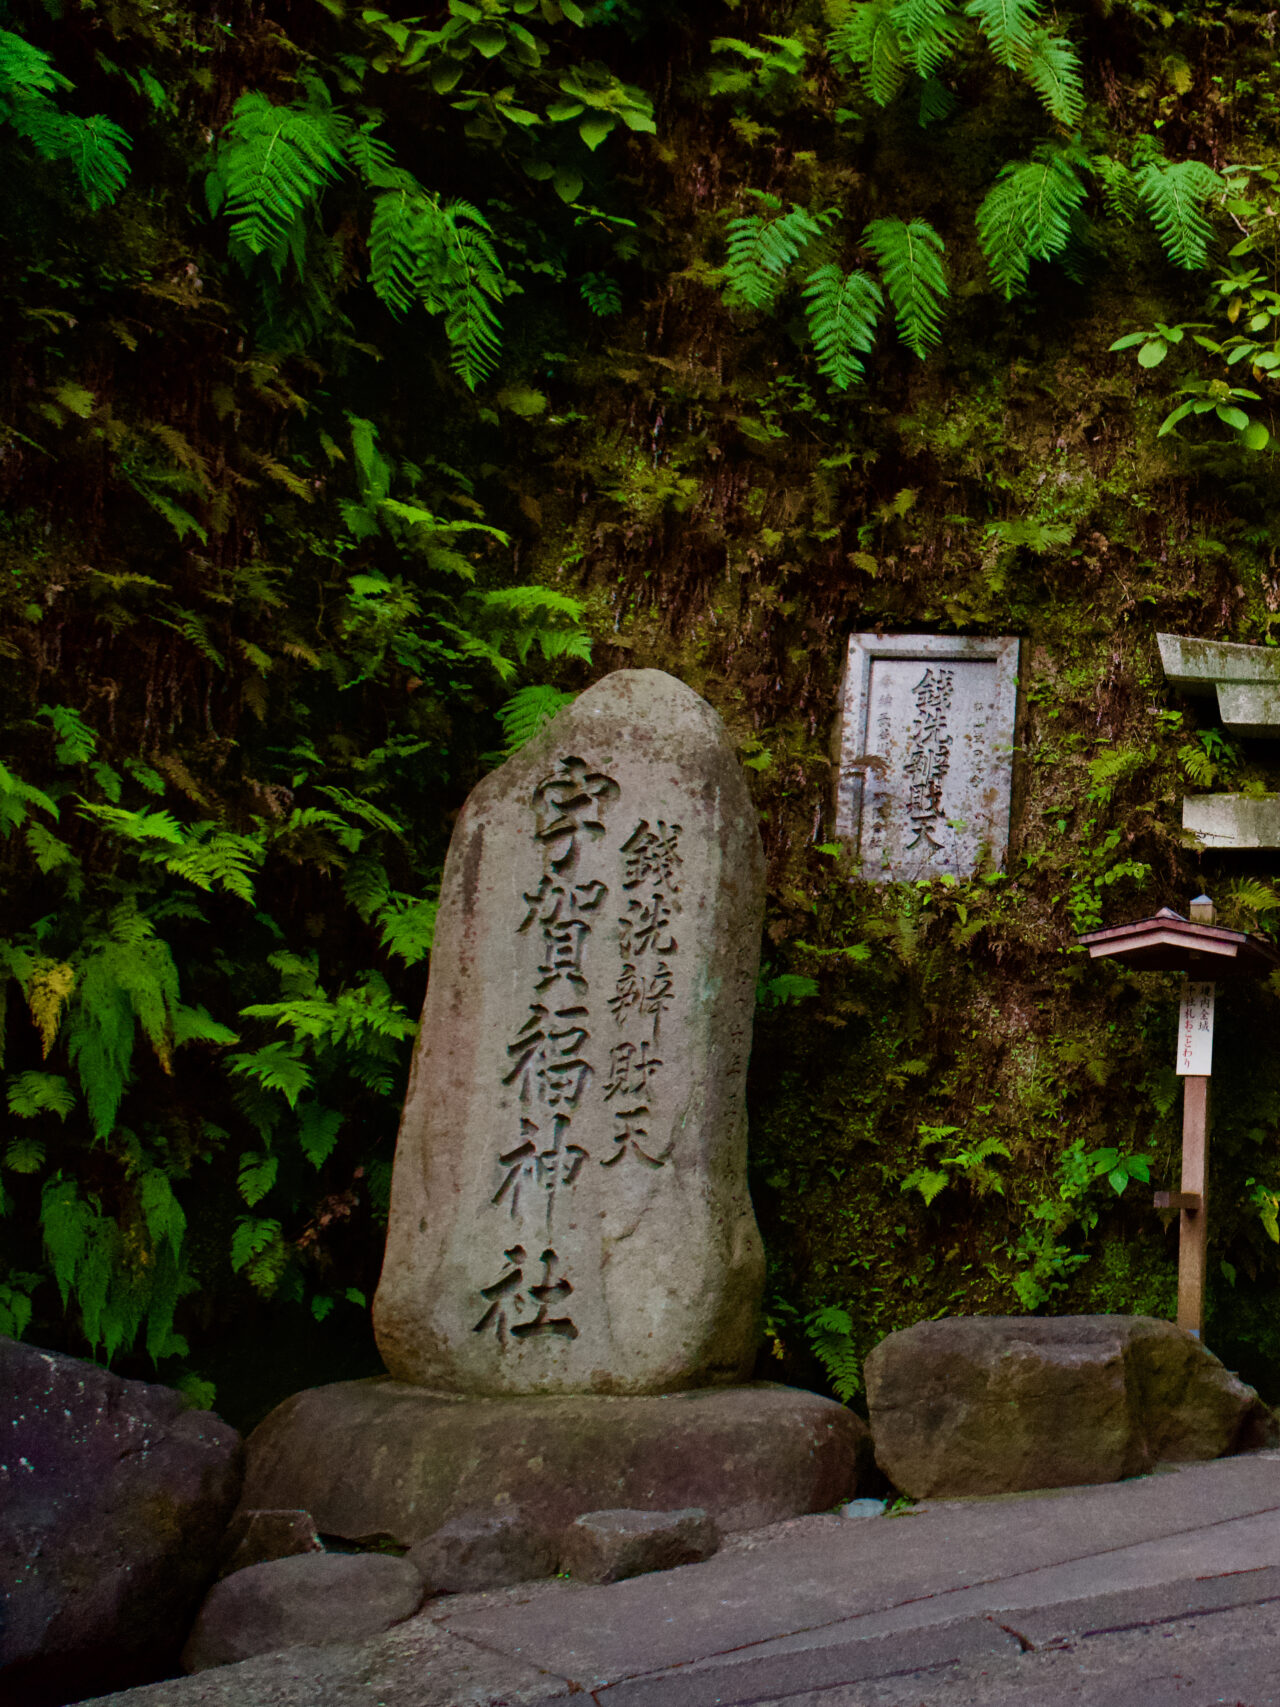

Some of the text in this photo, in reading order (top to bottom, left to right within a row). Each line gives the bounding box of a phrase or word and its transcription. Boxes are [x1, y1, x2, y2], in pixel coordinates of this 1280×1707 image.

[473, 755, 620, 1345] 宇賀福神社
